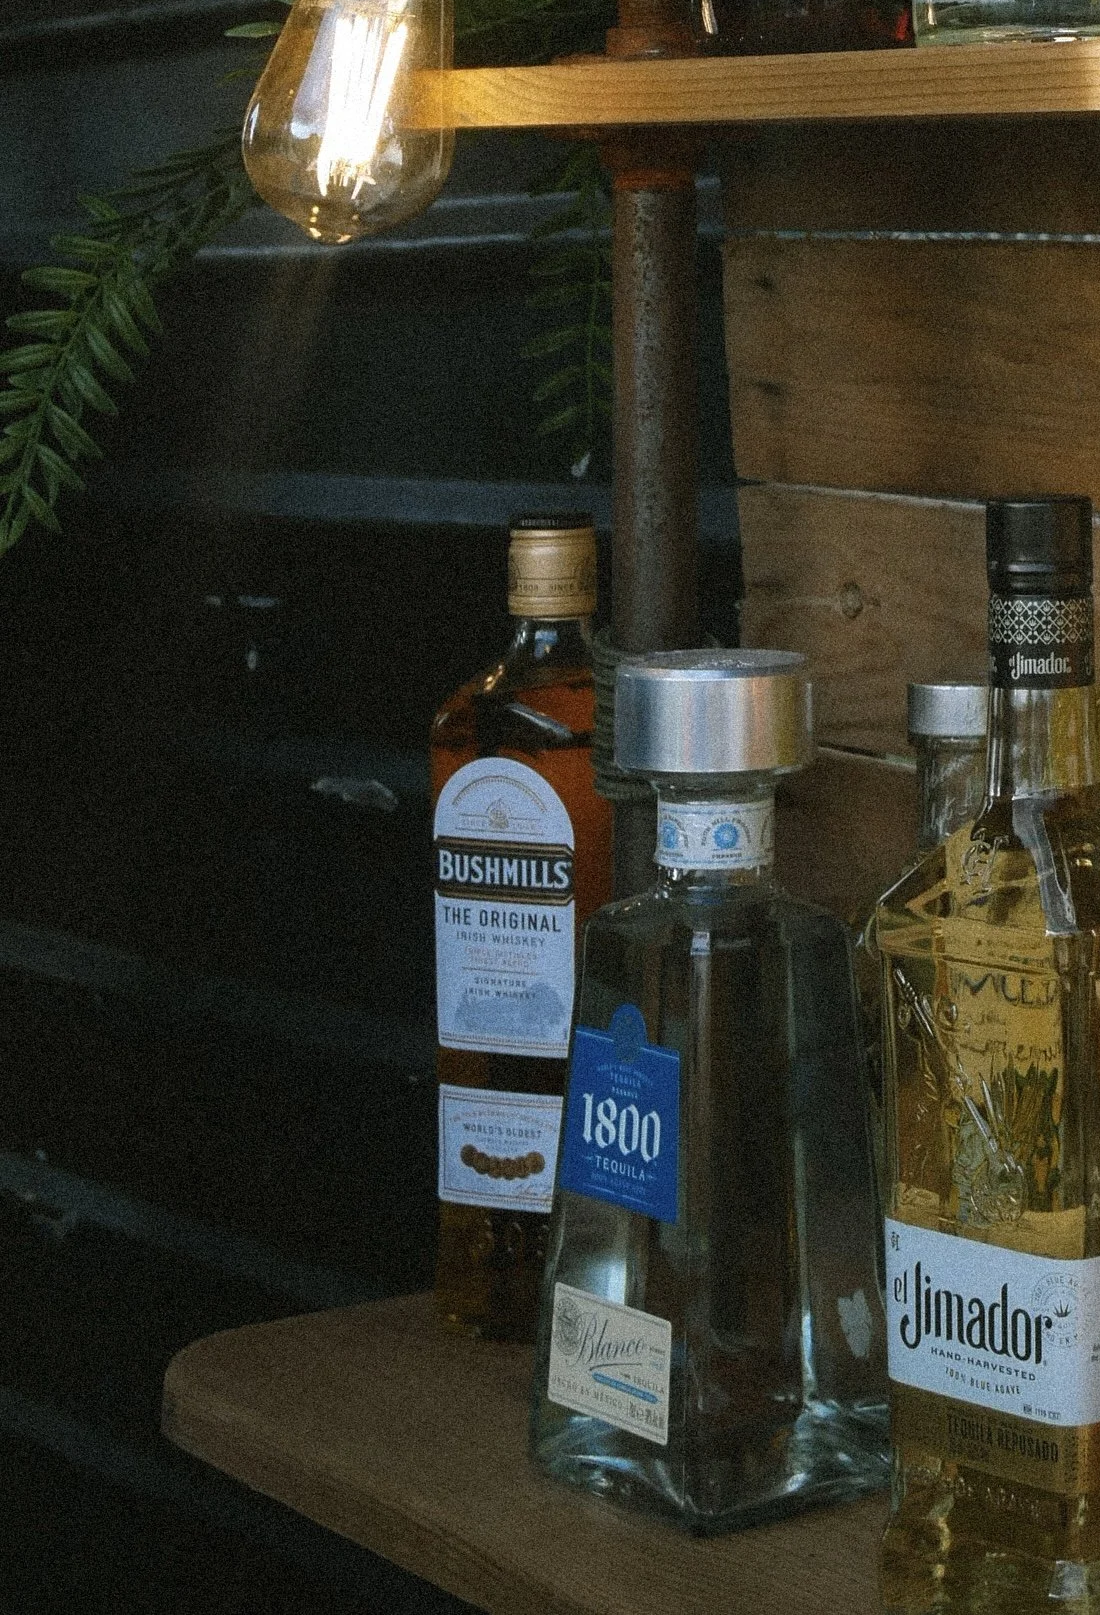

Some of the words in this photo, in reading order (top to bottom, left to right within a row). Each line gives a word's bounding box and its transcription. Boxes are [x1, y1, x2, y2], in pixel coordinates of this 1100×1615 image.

[1011, 651, 1069, 681] Jimador
[439, 848, 571, 889] BUSHMILLS
[443, 905, 471, 925] THE
[480, 909, 562, 933] ORIGINAL
[457, 930, 486, 943] IRISH
[492, 933, 546, 947] WHISKEY
[465, 987, 490, 997] IRISH
[495, 990, 537, 1000] WHISKEY
[474, 976, 526, 988] SIGNATURE
[463, 1122, 503, 1136] WORLD'S
[506, 1126, 542, 1139] OLDEST
[583, 1092, 661, 1164] 1800
[596, 1154, 645, 1182] TEQUILA
[893, 1269, 908, 1304] el
[899, 1260, 1053, 1365] Jimador
[930, 1346, 1037, 1383] HAND-HARVESTED
[945, 1366, 967, 1384] 100%
[969, 1376, 991, 1392] BLUE
[994, 1382, 1021, 1396] AGAVE
